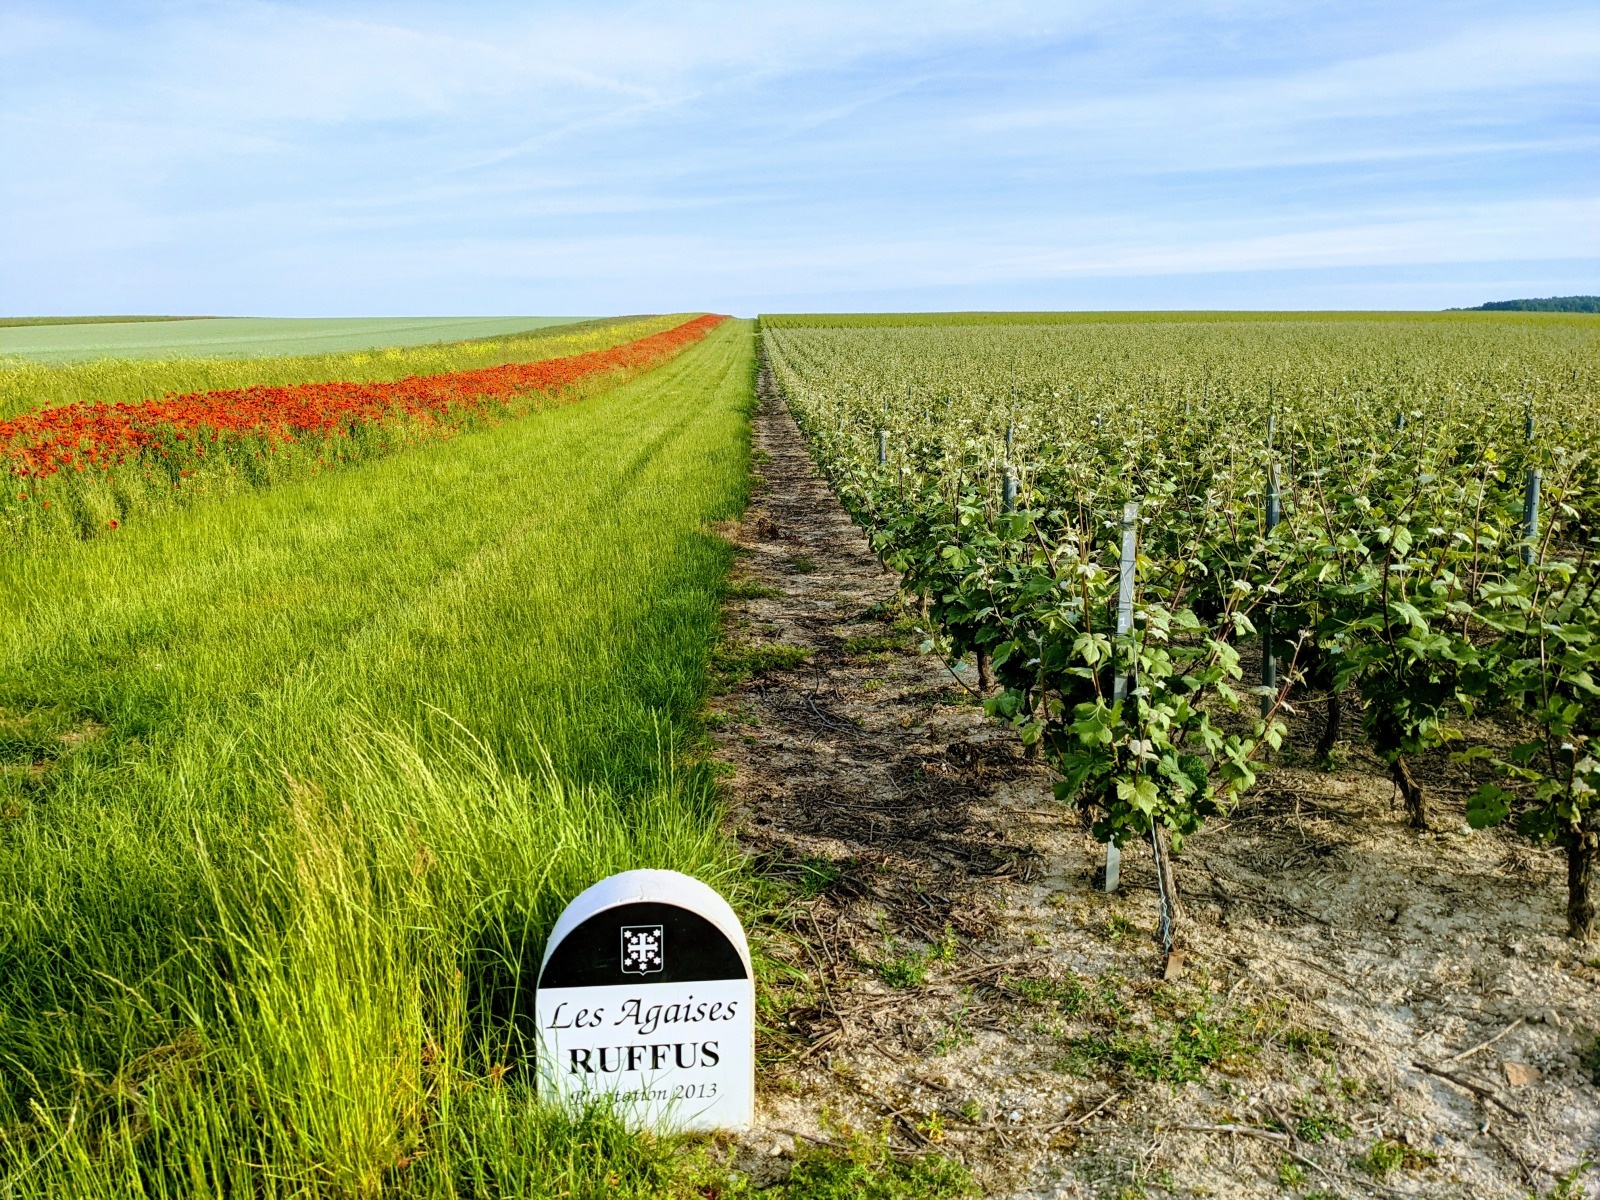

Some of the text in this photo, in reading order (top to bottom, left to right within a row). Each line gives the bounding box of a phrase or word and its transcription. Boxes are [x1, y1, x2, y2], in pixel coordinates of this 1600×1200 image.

[546, 995, 739, 1035] Les Agaises
[568, 1041, 720, 1074] RUFFUS
[570, 1083, 718, 1106] Patation 2013
